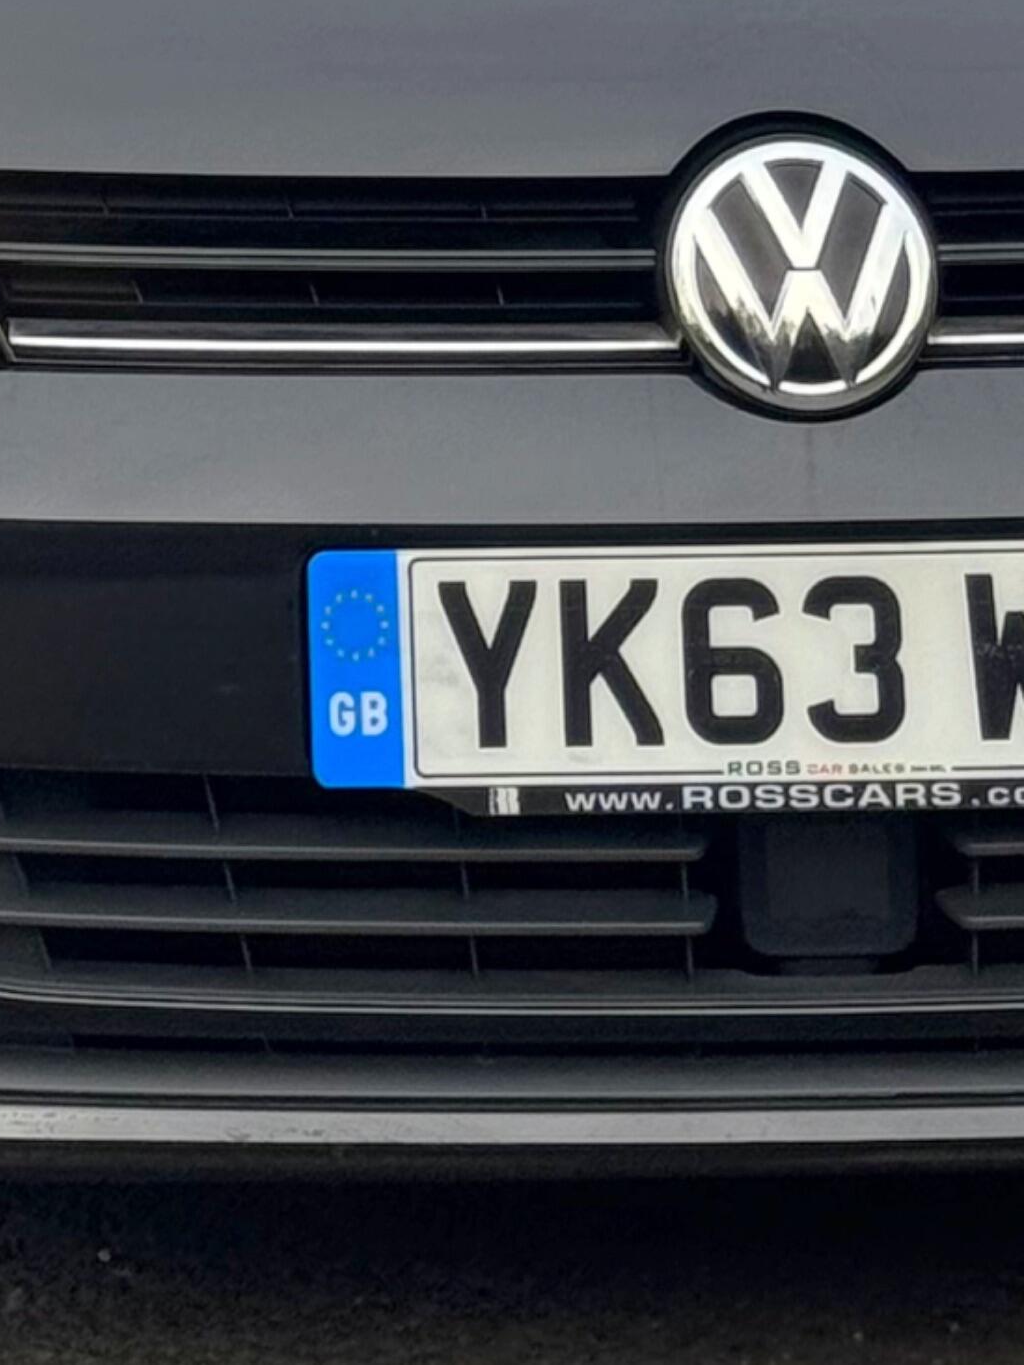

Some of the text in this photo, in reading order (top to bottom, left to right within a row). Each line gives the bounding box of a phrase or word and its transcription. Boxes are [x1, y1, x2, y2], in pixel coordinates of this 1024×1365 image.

[438, 575, 906, 748] YK63
[329, 691, 388, 736] GB
[728, 760, 801, 775] ROSS
[807, 763, 842, 774] CAR
[848, 763, 905, 774] SALES
